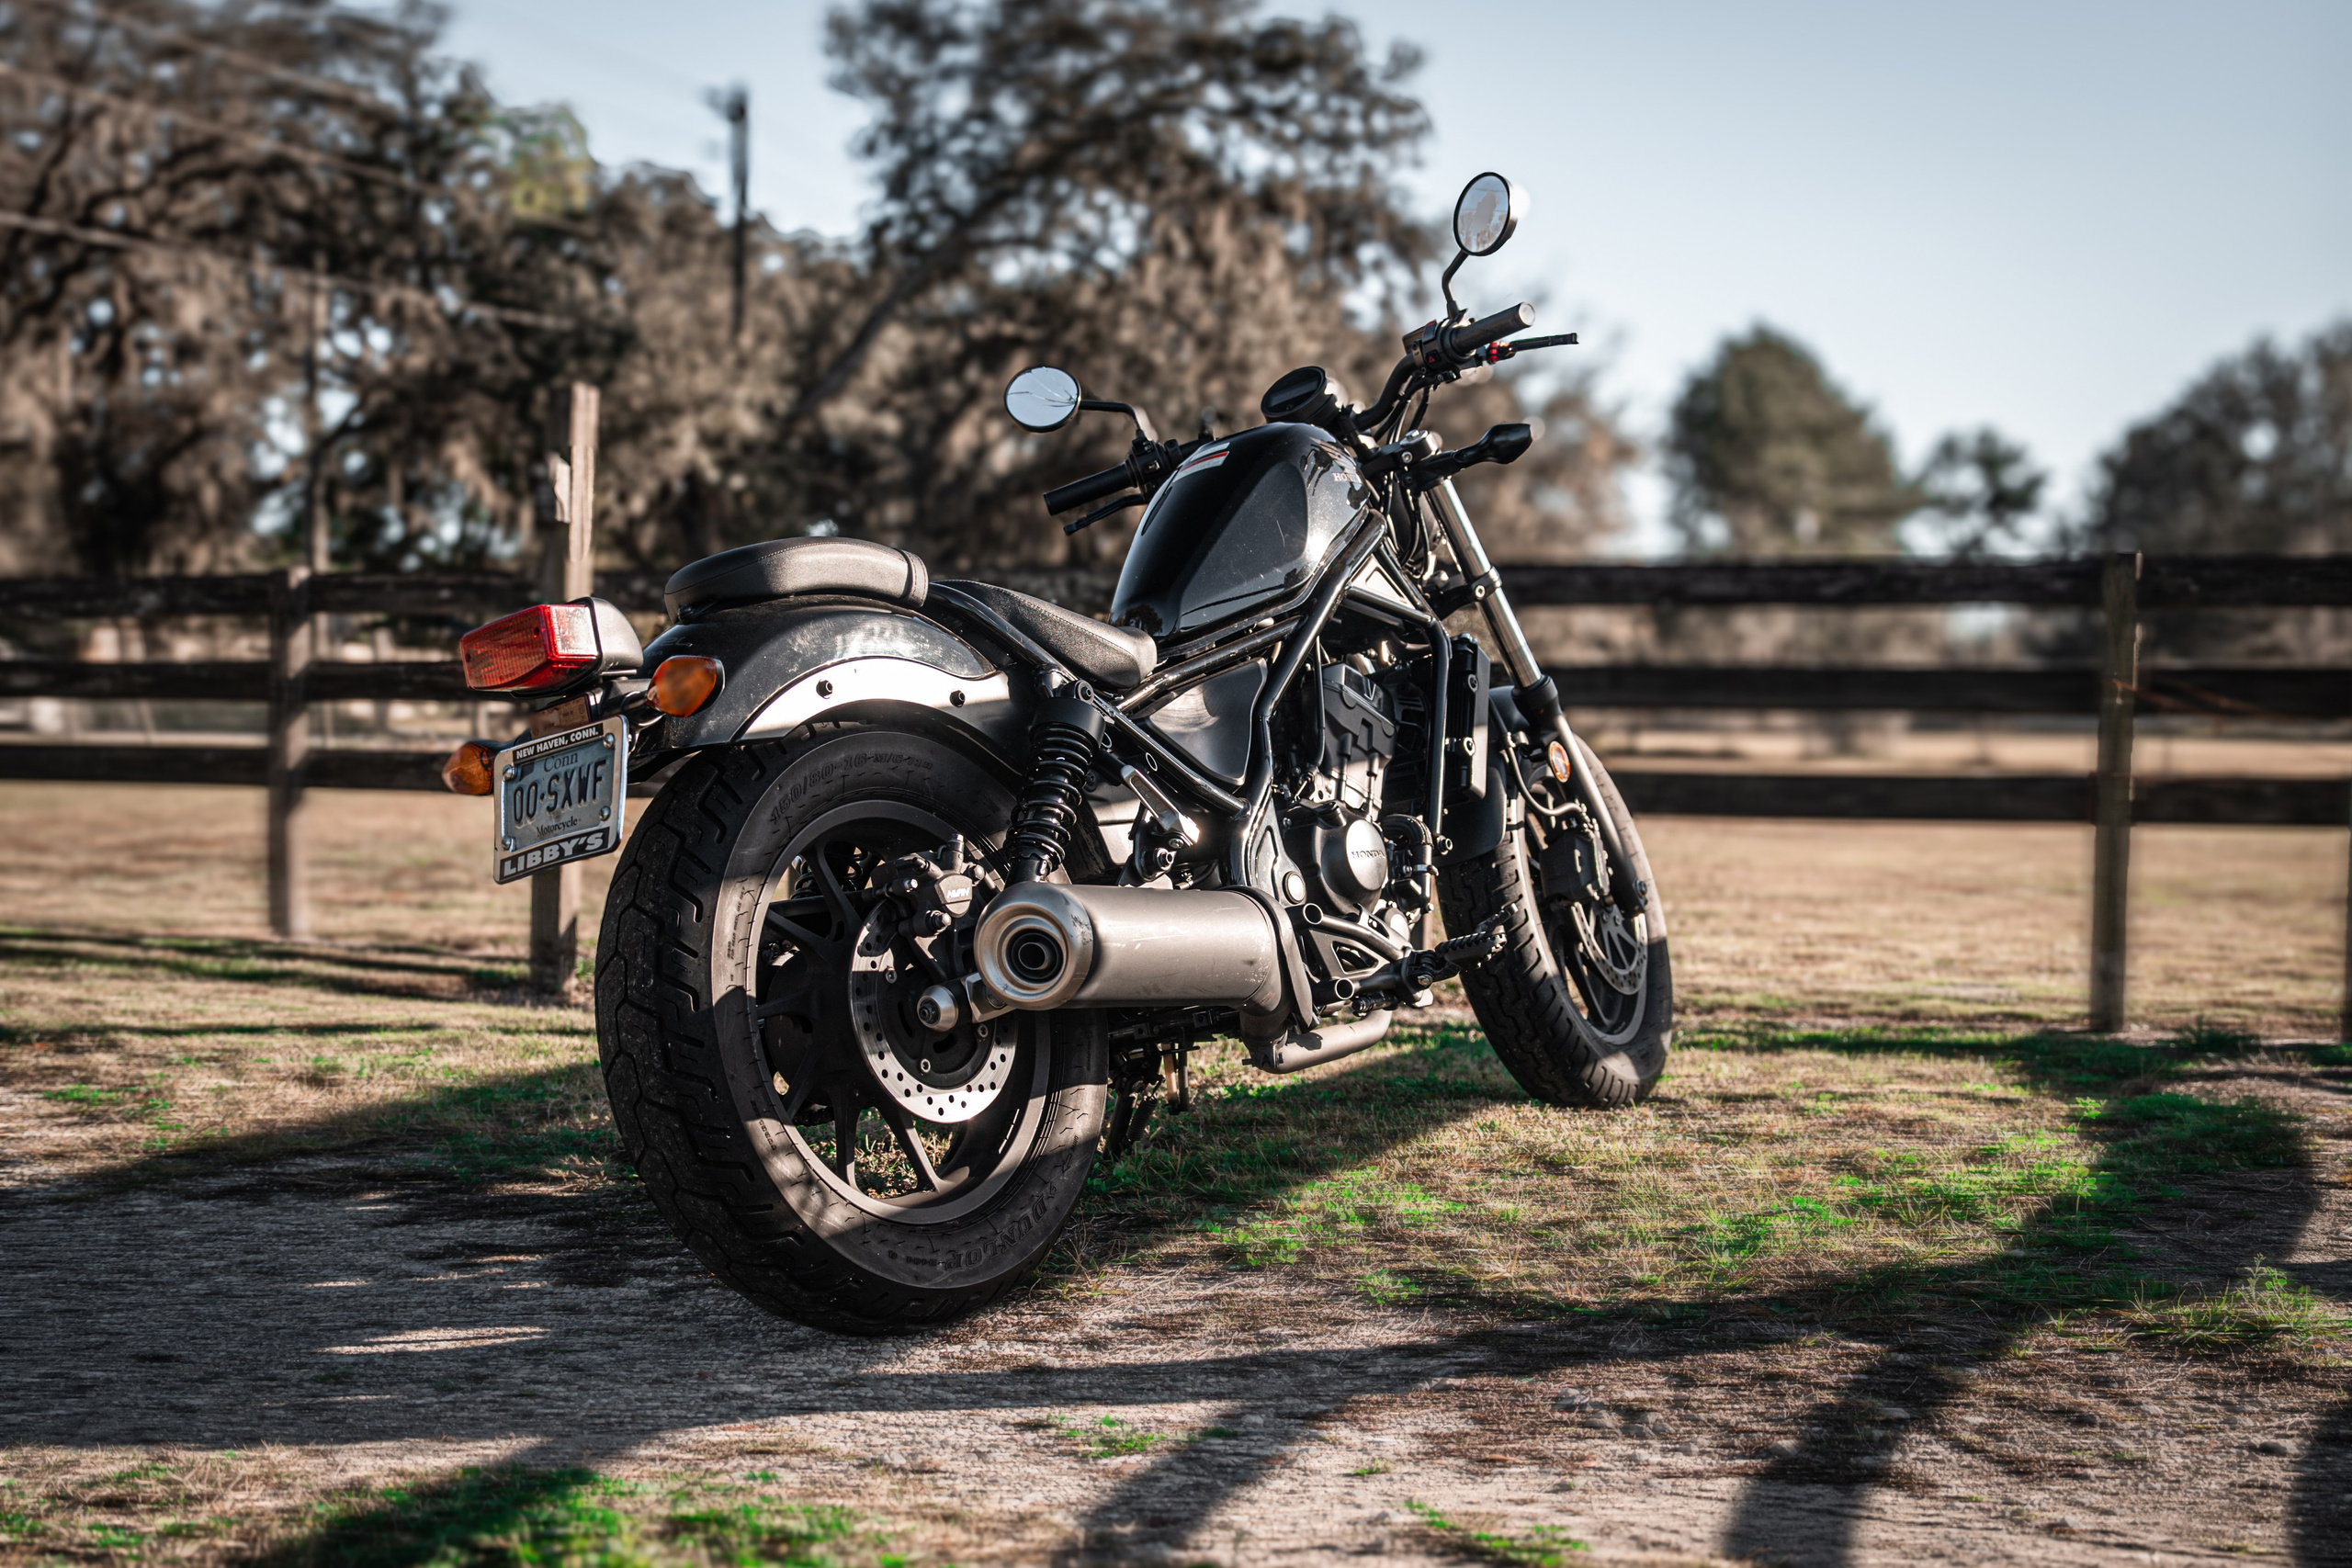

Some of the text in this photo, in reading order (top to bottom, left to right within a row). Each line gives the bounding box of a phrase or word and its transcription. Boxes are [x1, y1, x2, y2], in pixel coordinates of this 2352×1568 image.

[516, 728, 598, 760] NEW HAVEN, CONN.
[544, 752, 578, 772] Conn
[536, 817, 578, 838] Motorcycle
[503, 832, 604, 876] LIBBY'S
[1351, 850, 1385, 859] HONDA
[944, 1194, 1047, 1270] DUNLOP
